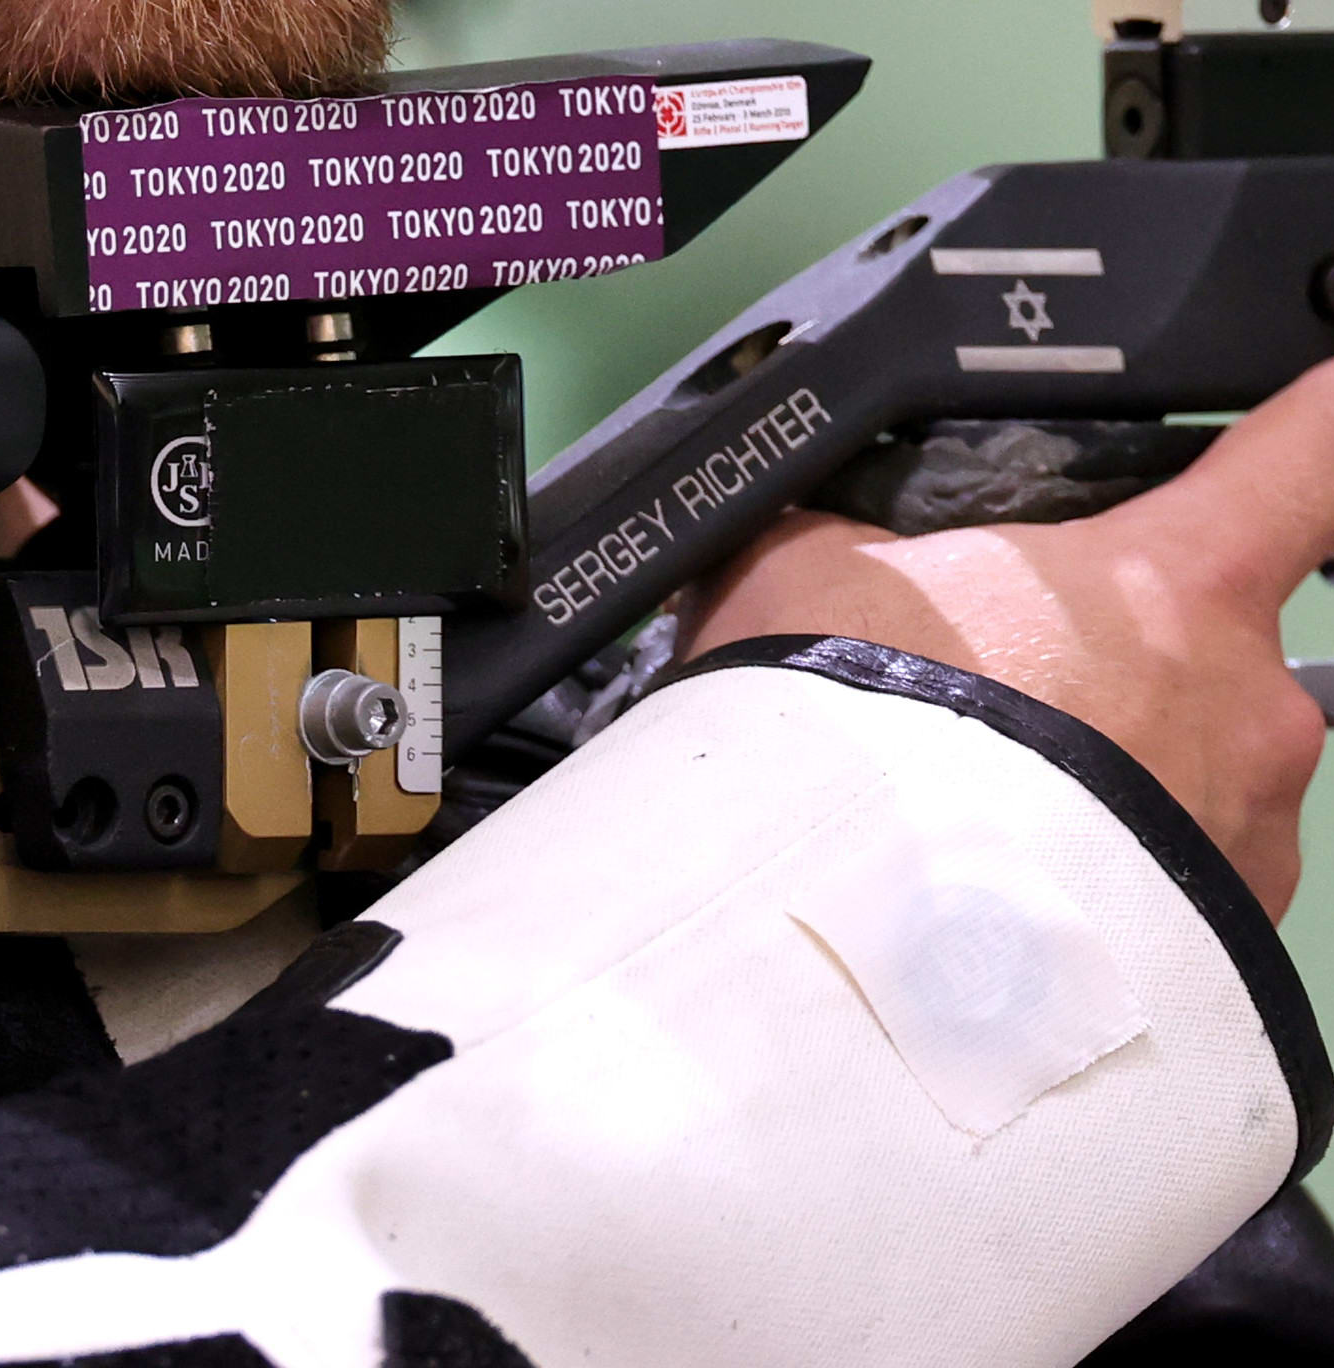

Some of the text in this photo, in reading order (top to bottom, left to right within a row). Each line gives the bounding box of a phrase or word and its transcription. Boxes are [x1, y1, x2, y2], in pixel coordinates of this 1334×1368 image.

[116, 110, 180, 142] 2020
[202, 105, 289, 137] TOKYO
[294, 101, 358, 132] 2020
[381, 95, 468, 127] TOKYO
[472, 91, 536, 122] 2020
[559, 84, 646, 117] TOKYO
[130, 165, 218, 198] TOKYO
[223, 161, 286, 192] 2020
[308, 154, 394, 187] TOKYO
[400, 151, 464, 183] 2020
[486, 145, 573, 178] TOKYO
[578, 141, 642, 173] 2020
[123, 223, 187, 255] 2020
[211, 217, 296, 250] TOKYO
[301, 213, 365, 245] 2020
[387, 207, 474, 240] TOKYO
[479, 203, 543, 235] 2020
[566, 196, 652, 229] TOKYO
[136, 278, 222, 309] TOKYO
[228, 274, 290, 304] 2020
[313, 267, 400, 299] TOKYO
[405, 263, 468, 293] 2020
[492, 256, 577, 287] TOKYO
[533, 387, 832, 626] SERGEY RICHTER
[407, 642, 417, 658] 3
[407, 678, 417, 692] 4
[407, 712, 417, 727] 5
[406, 746, 416, 761] 6
